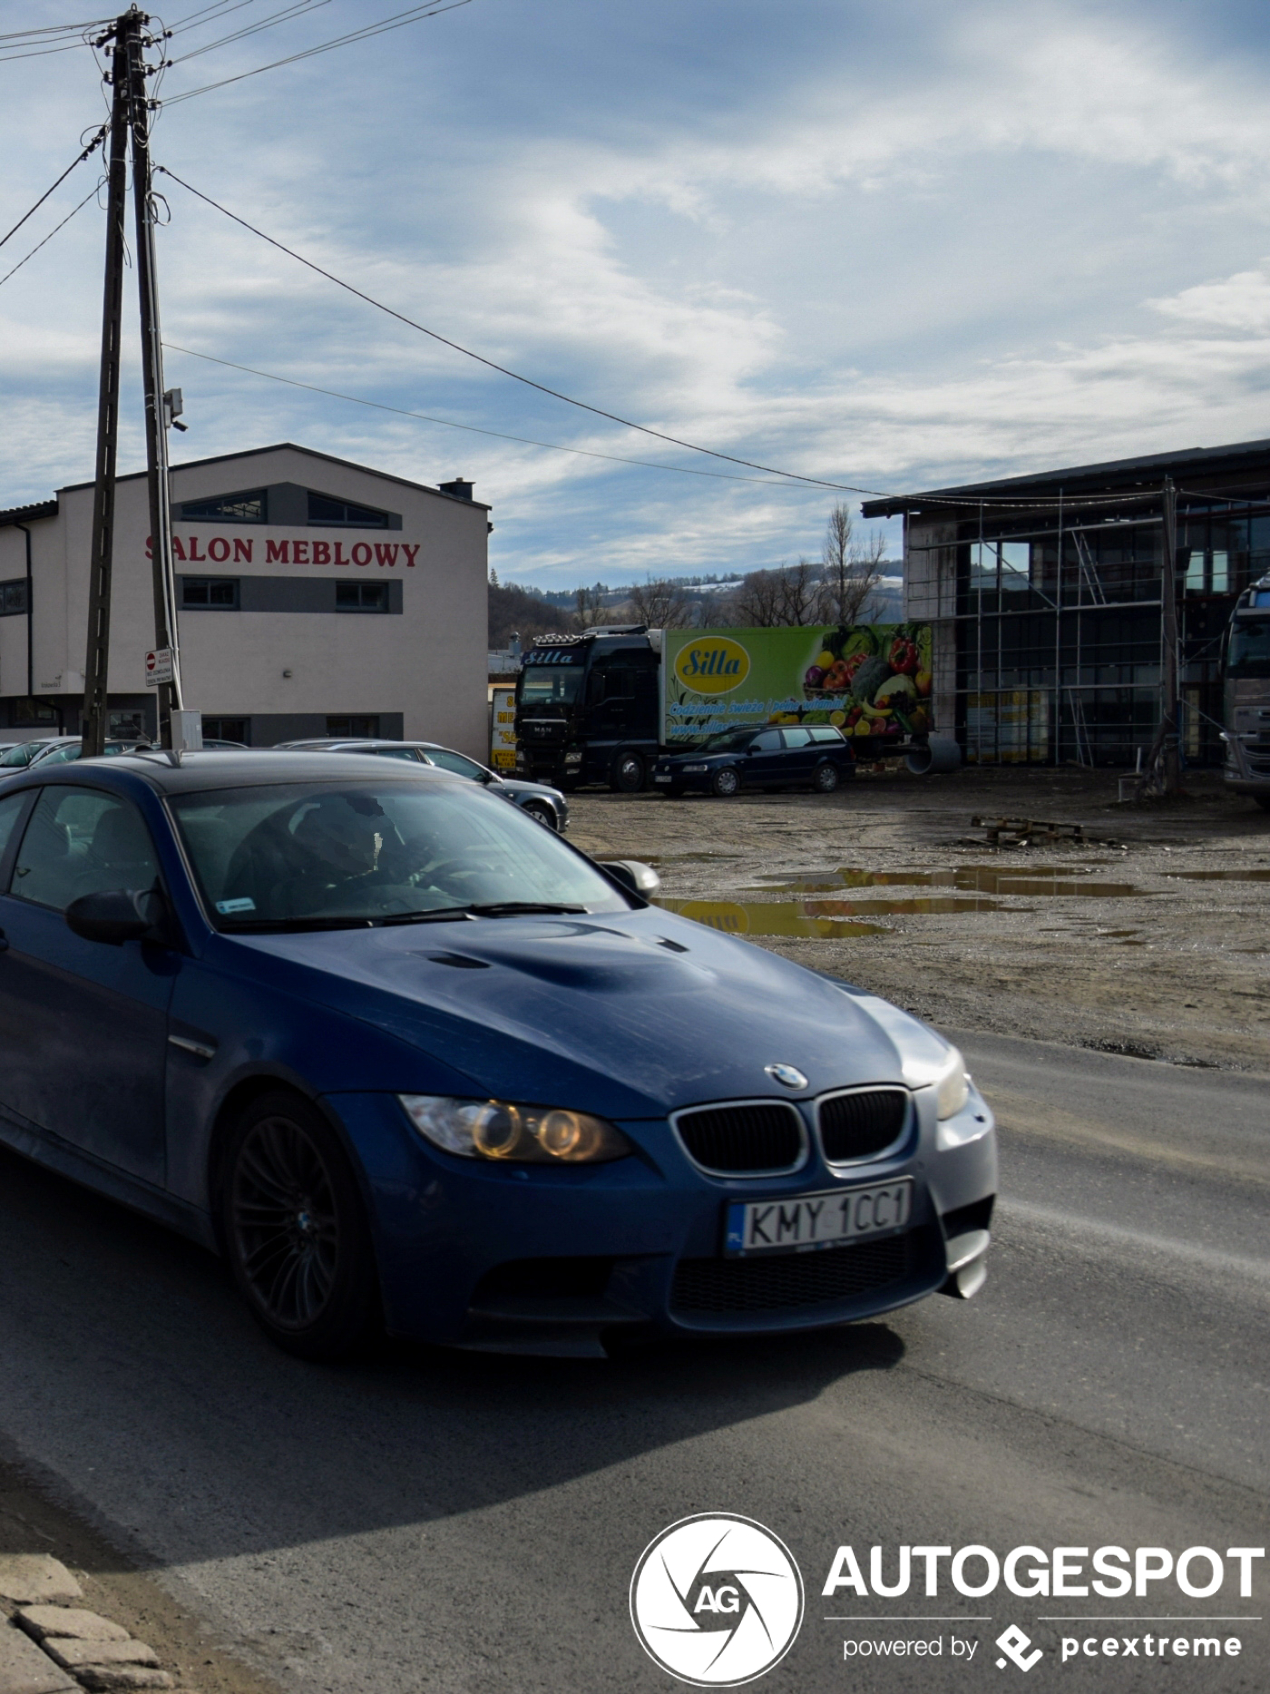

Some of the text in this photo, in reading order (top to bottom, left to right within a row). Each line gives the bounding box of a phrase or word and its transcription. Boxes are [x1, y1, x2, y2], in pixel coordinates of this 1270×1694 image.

[266, 540, 420, 567] MEBLOWY
[524, 651, 573, 664] Silla
[682, 649, 741, 676] Silla
[670, 701, 726, 715] Codziennie
[750, 1187, 904, 1245] KMY 1CC1
